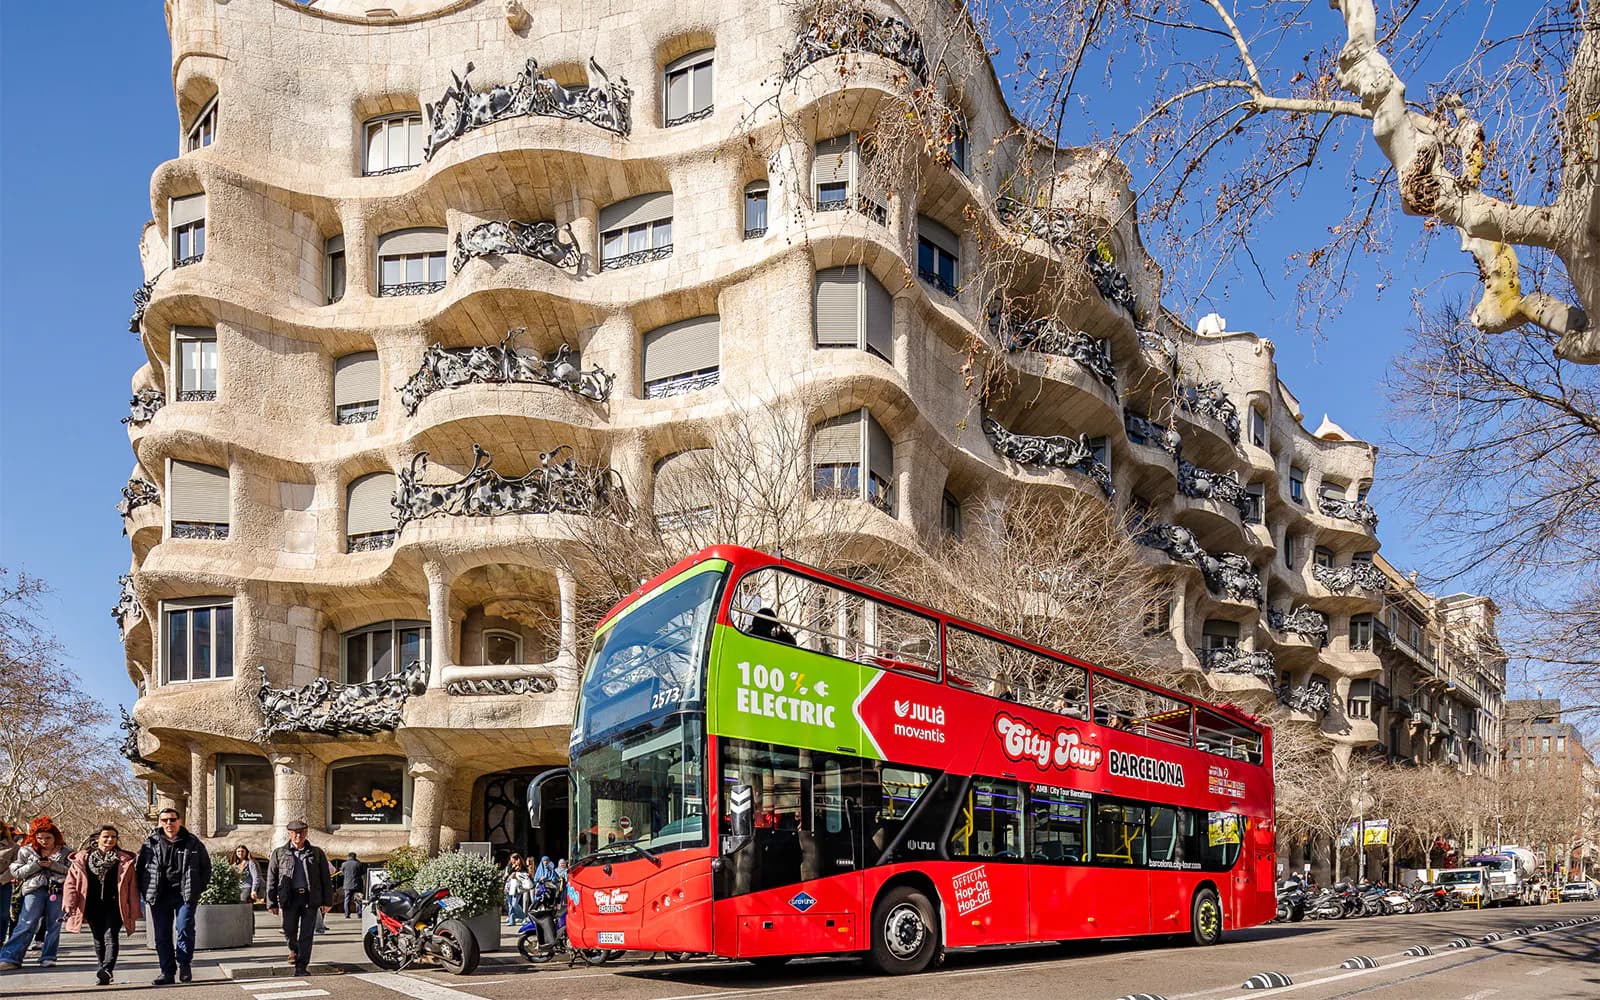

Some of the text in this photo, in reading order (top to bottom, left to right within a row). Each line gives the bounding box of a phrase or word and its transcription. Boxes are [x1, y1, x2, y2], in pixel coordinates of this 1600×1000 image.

[737, 661, 785, 692] 100
[651, 686, 680, 710] 2573
[736, 687, 836, 729] ELECTRIC
[894, 723, 946, 744] moventis
[997, 717, 1101, 767] City Tour
[1108, 749, 1186, 788] BARCELONA
[952, 868, 987, 890] OFFICIAL
[954, 880, 989, 902] Hop-On
[957, 888, 991, 913] Hop-Off
